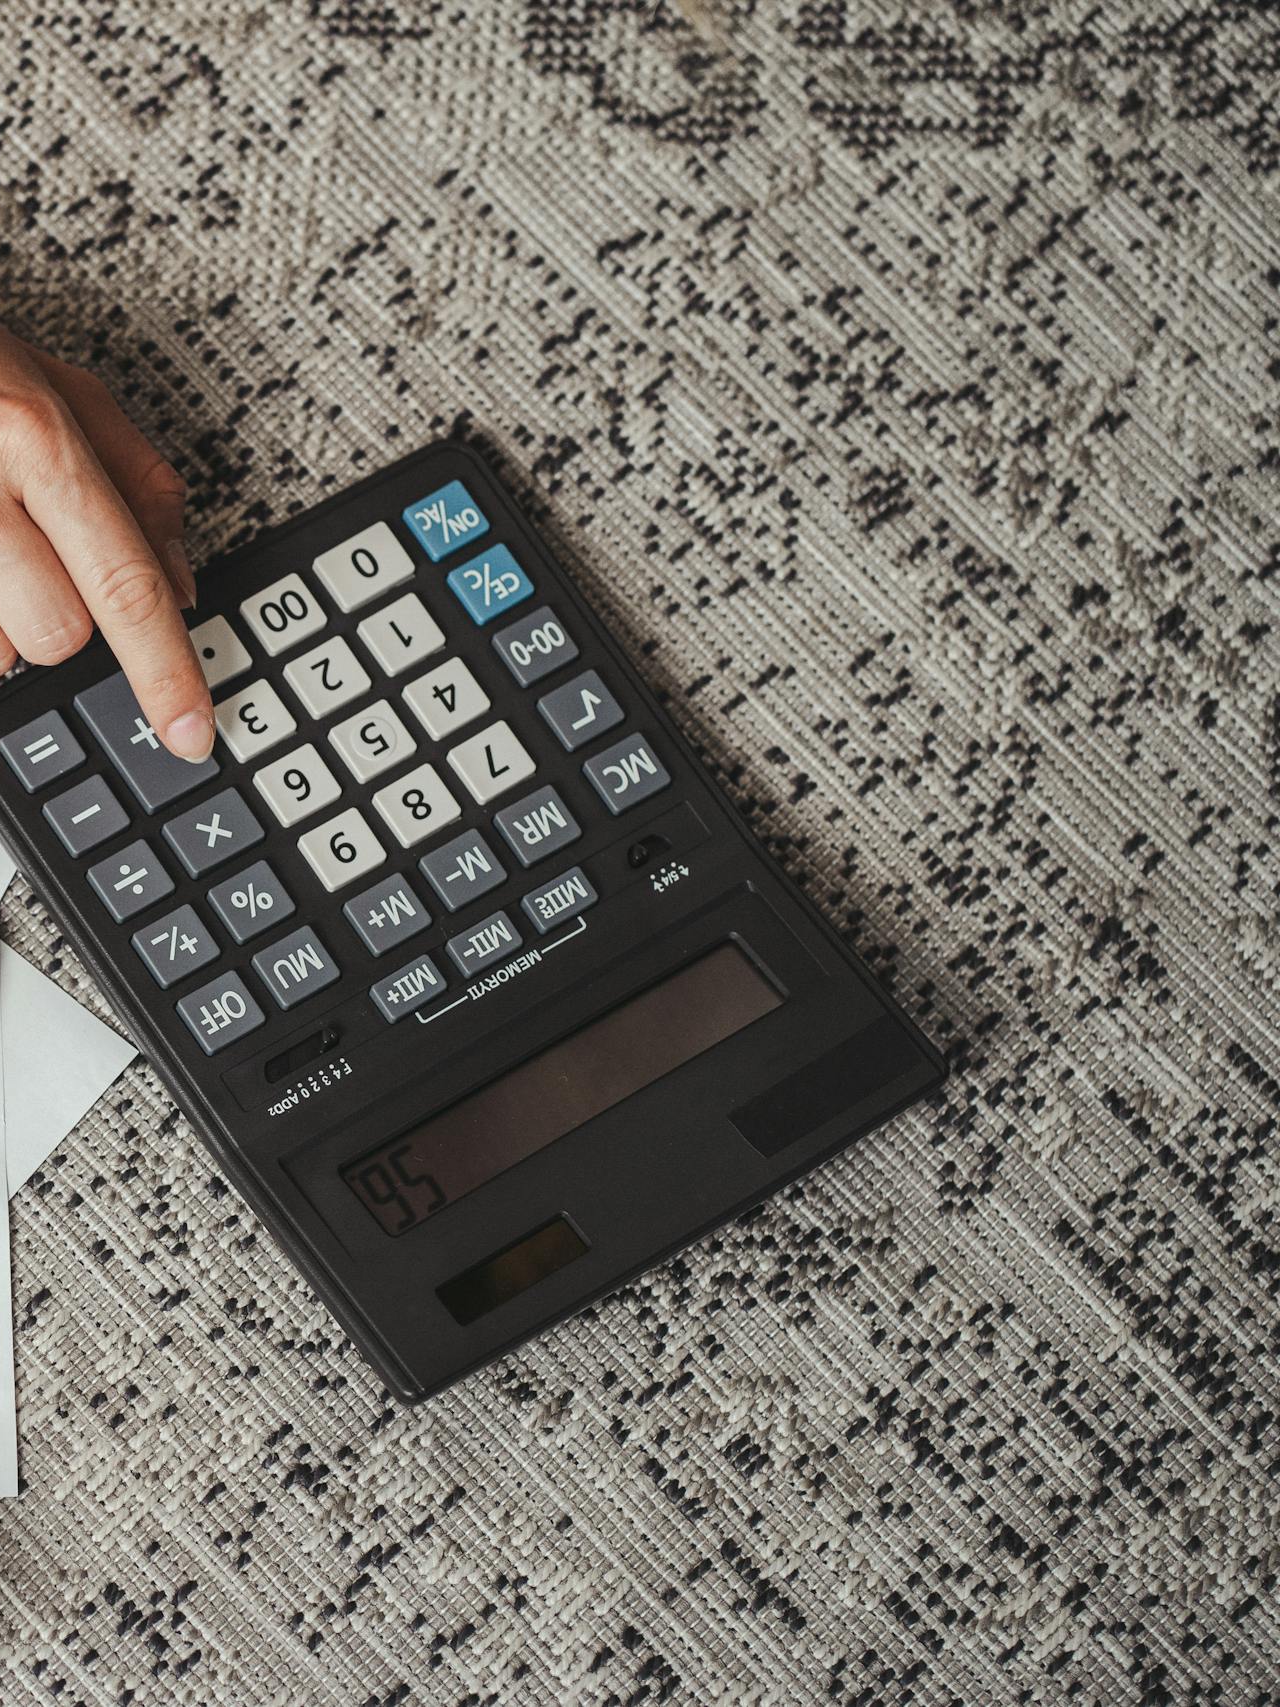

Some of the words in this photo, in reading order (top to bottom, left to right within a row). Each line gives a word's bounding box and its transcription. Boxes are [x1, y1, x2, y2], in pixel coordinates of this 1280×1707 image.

[414, 499, 480, 544] ON/AC
[351, 547, 380, 578] 0
[463, 562, 522, 607] CE/C
[259, 590, 309, 633] 00
[389, 620, 413, 648] 1
[310, 657, 344, 692] 2
[431, 682, 457, 714] 4
[238, 701, 269, 735] 3
[360, 721, 391, 757] 5
[484, 743, 511, 779] 7
[601, 746, 658, 795] MC
[282, 768, 312, 803] 6
[401, 788, 433, 821] 8
[512, 800, 568, 846] MR
[329, 831, 358, 865] 9
[445, 845, 493, 883] M-
[368, 889, 417, 928] M+
[272, 943, 325, 990] MU
[199, 989, 247, 1036] OFF
[321, 1074, 332, 1087] 3
[342, 1061, 354, 1076] F
[310, 1081, 321, 1094] 2
